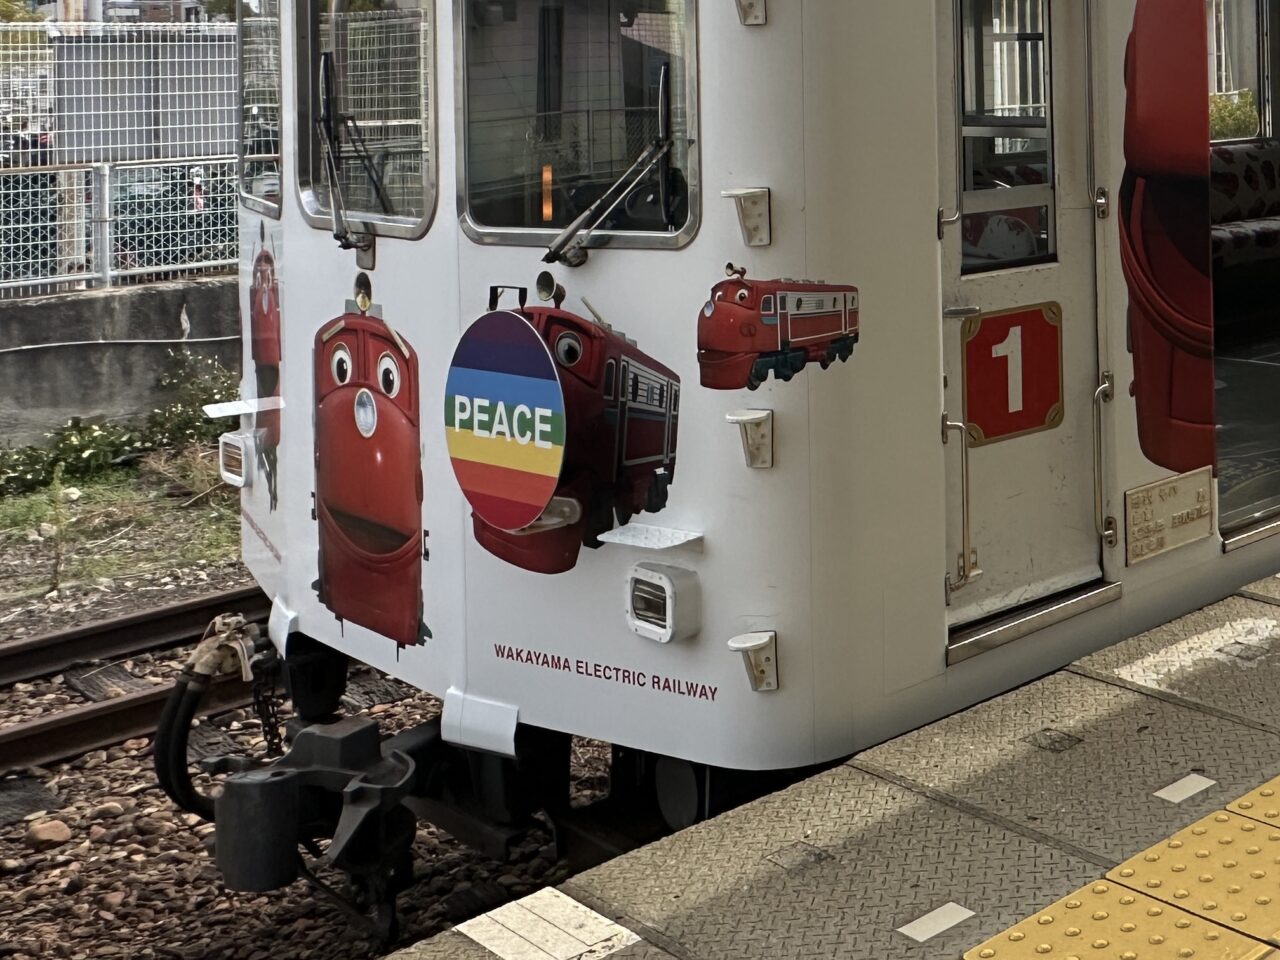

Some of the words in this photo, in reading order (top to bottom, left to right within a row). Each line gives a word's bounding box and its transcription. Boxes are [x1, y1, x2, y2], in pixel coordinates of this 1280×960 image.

[991, 325, 1023, 413] 1
[454, 393, 554, 451] PEACE
[494, 643, 572, 672] WAKAYAMA
[575, 660, 647, 688] ELECTRIC
[651, 675, 718, 702] RAILWAY
